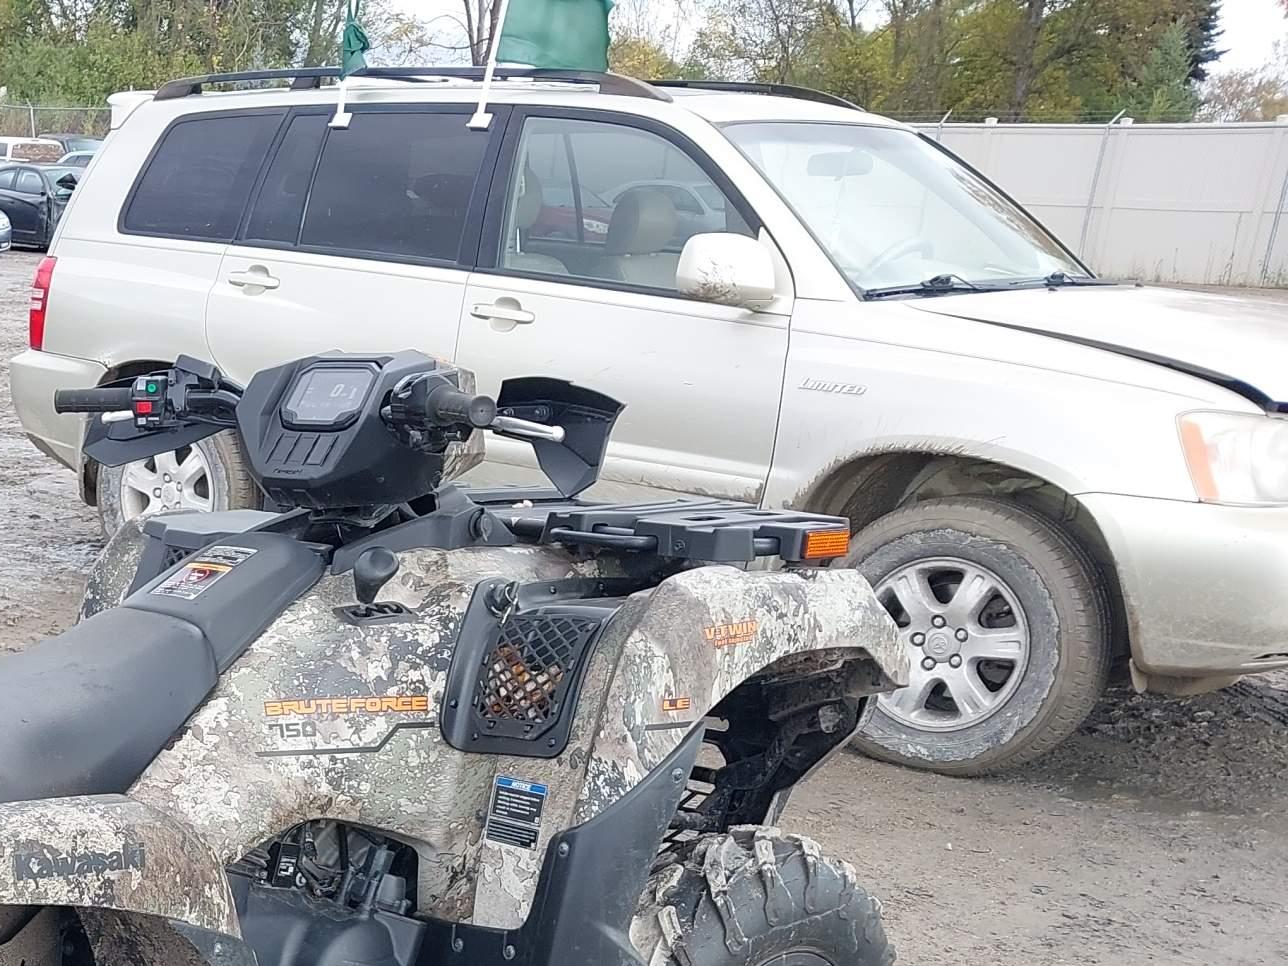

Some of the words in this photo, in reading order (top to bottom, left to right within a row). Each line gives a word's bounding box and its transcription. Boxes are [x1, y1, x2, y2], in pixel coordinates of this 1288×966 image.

[797, 377, 868, 396] LIMITED
[263, 699, 349, 717] BRUTE
[350, 695, 429, 713] FORCE
[662, 698, 691, 712] LE
[268, 721, 317, 739] 750
[14, 842, 145, 881] Kawasaki
